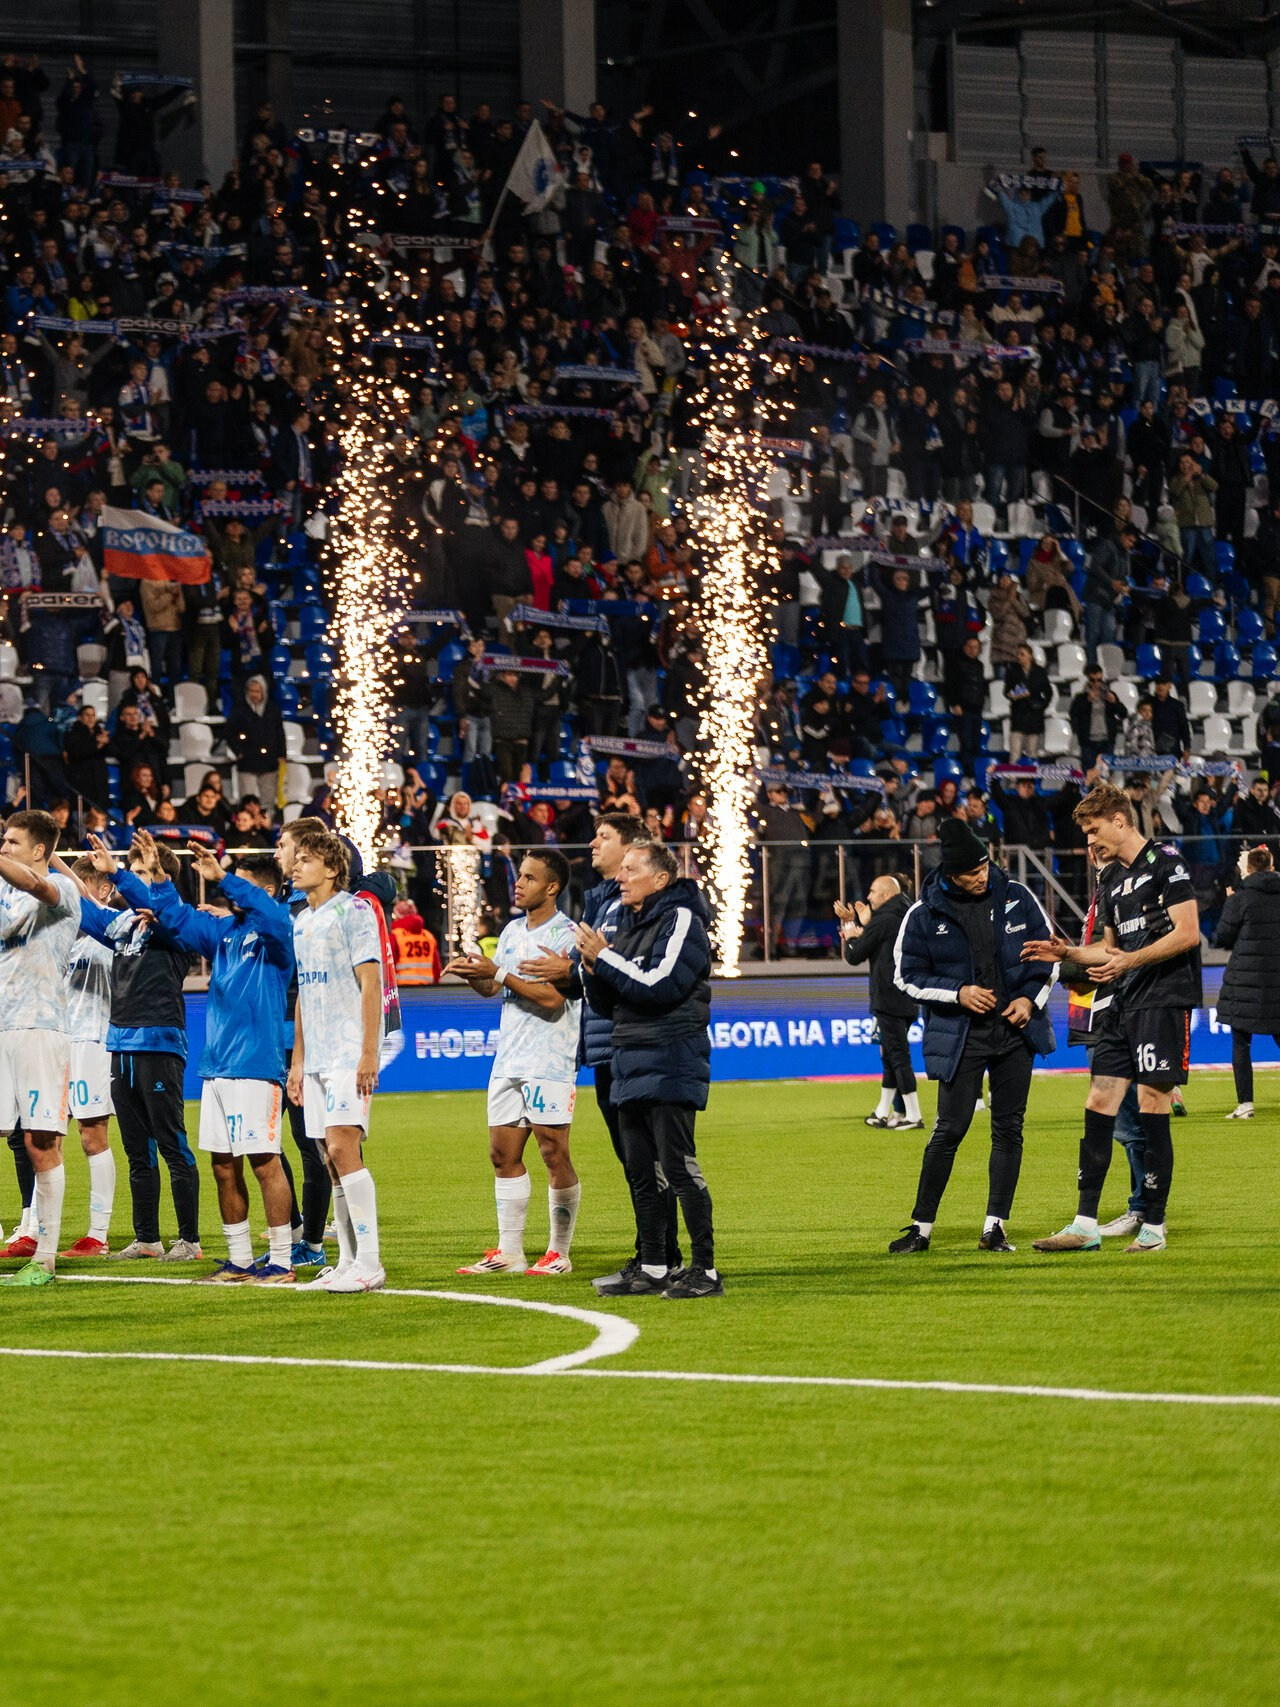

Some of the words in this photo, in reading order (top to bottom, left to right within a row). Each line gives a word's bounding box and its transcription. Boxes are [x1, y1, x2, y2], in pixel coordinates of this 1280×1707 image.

[405, 941, 431, 957] 259
[415, 1029, 501, 1059] НОВА
[709, 1020, 783, 1048] БОТА
[787, 1019, 826, 1047] НА
[1136, 1043, 1156, 1073] 16
[28, 1089, 40, 1118] 7
